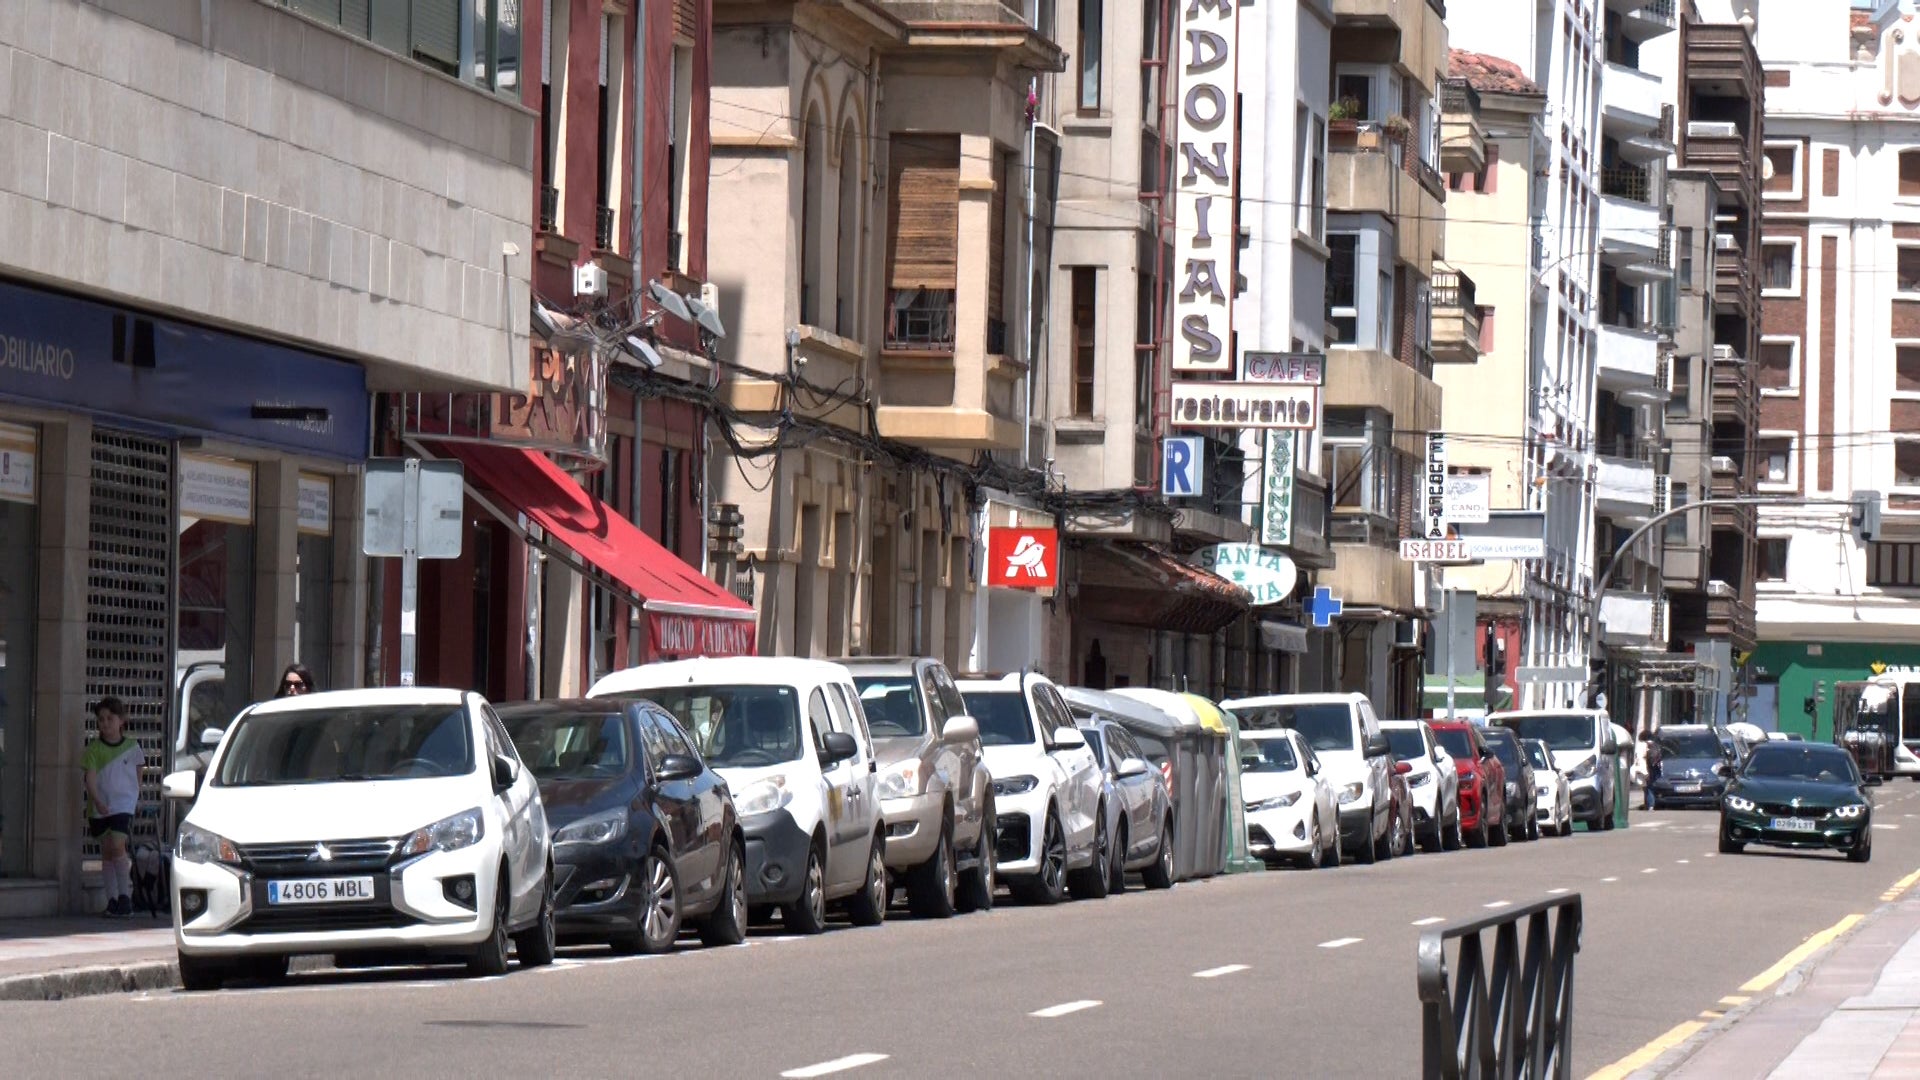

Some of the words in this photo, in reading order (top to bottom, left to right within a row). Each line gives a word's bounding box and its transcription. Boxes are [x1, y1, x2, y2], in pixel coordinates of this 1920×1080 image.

[1249, 355, 1320, 382] CAFE
[1174, 394, 1311, 425] restaurante
[1201, 547, 1281, 574] SANTA
[1403, 542, 1468, 559] ISABEL
[660, 616, 695, 651] HORNO
[701, 620, 748, 655] CADENAS
[282, 882, 328, 899] 4806
[334, 881, 369, 898] MBL
